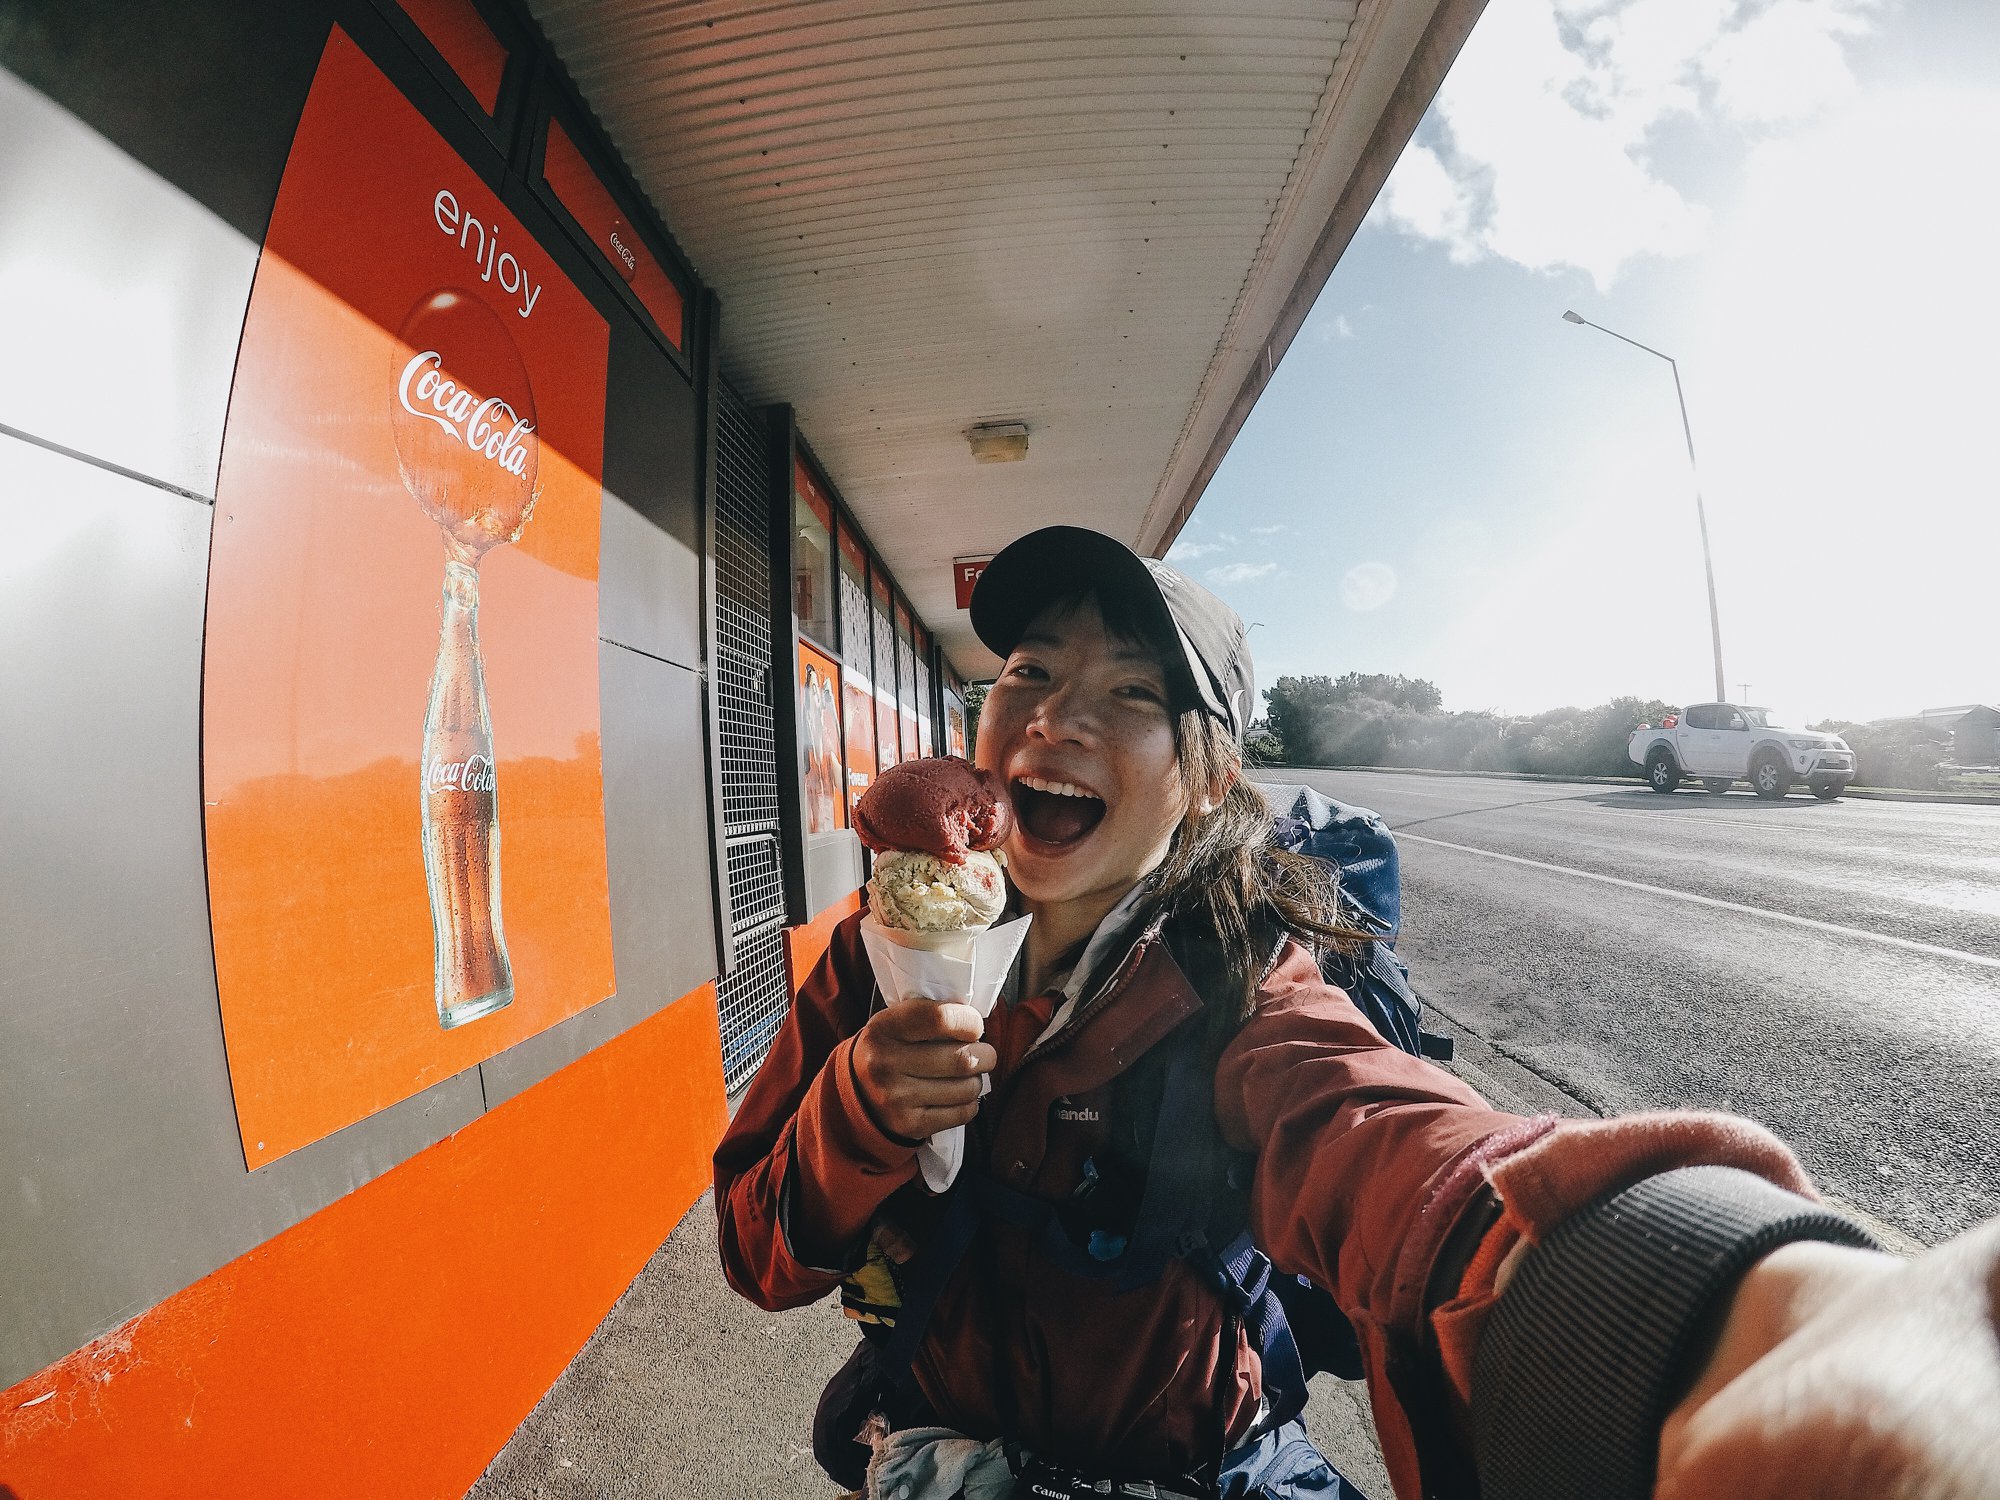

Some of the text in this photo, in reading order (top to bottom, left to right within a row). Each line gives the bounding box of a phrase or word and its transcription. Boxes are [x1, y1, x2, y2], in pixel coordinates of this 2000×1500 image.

[434, 189, 541, 318] enjoy
[610, 232, 635, 270] Coca-Cola
[398, 350, 536, 480] Coca-Cola
[426, 754, 496, 795] Coca-Cola
[1057, 1107, 1099, 1121] andu
[1031, 1484, 1071, 1500] Canon
